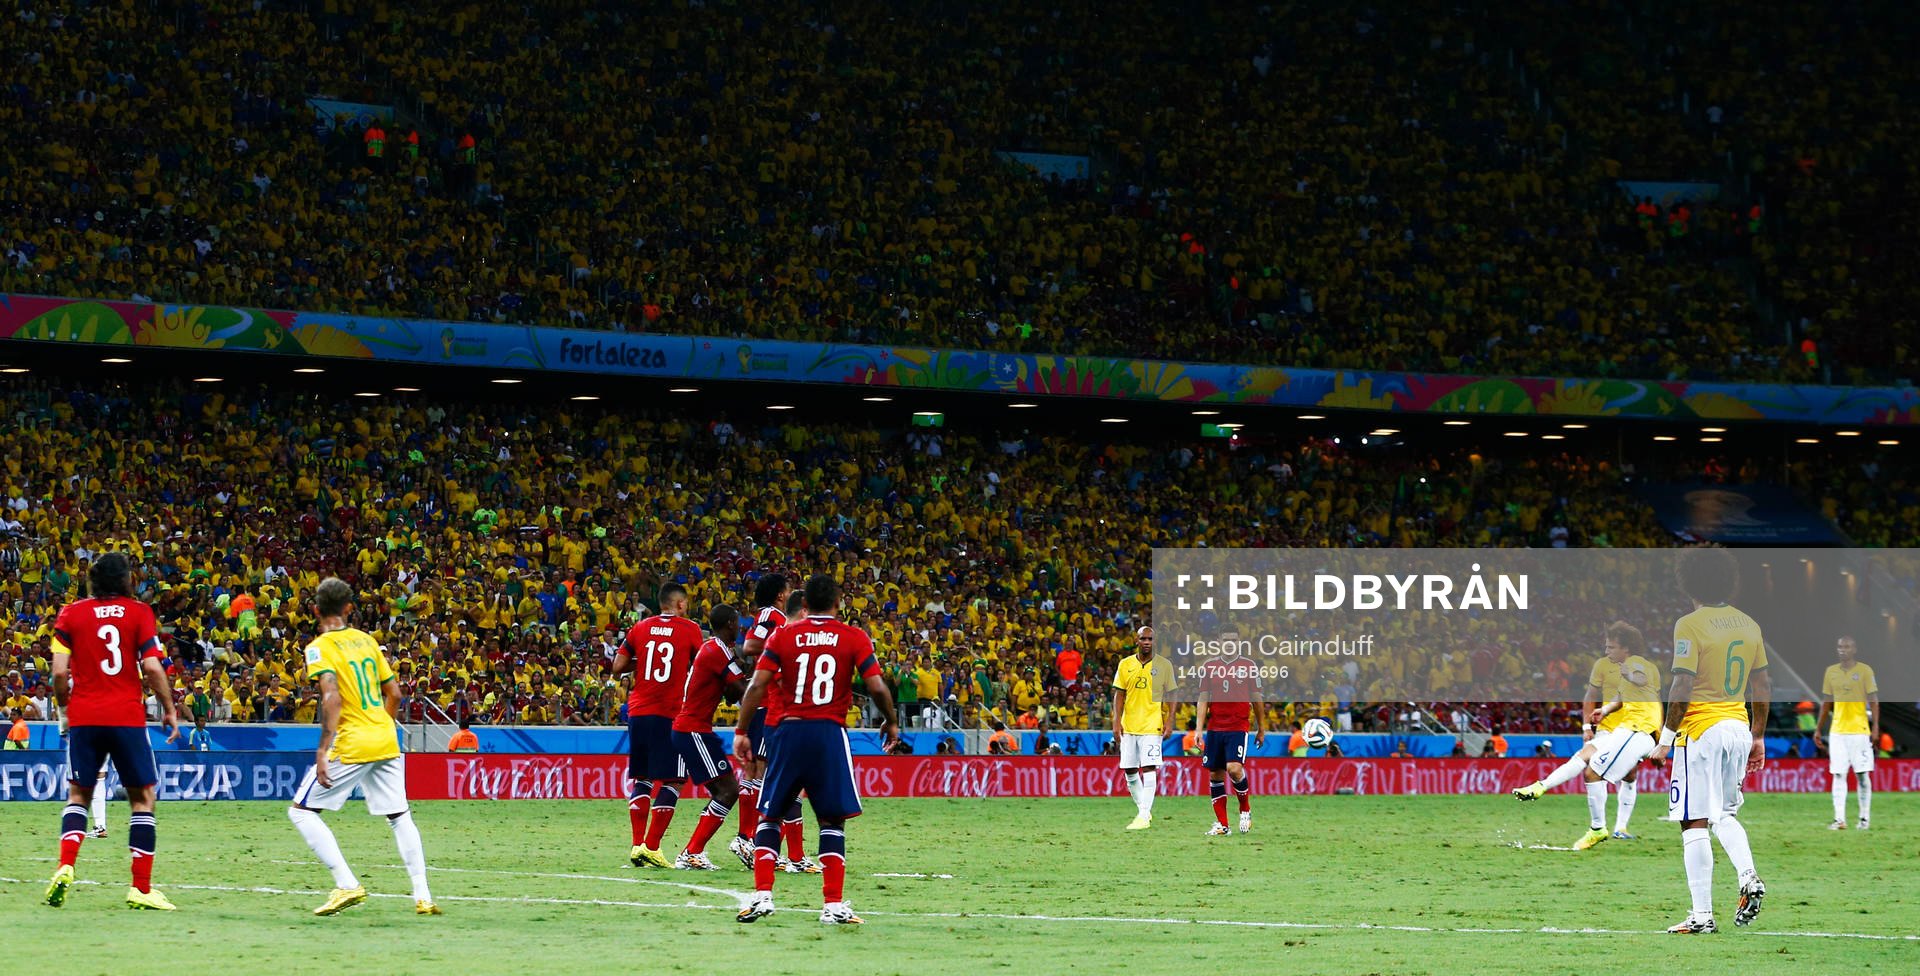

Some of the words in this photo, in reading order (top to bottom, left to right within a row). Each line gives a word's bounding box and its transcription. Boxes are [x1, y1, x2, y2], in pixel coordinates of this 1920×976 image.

[93, 605, 126, 619] YEPES
[97, 624, 123, 676] 3
[644, 640, 674, 683] 13
[1724, 640, 1745, 696] 6
[349, 656, 381, 710] 10
[794, 652, 837, 706] 18
[1135, 676, 1148, 689] 23
[1222, 679, 1230, 693] 9
[1147, 744, 1161, 758] 23
[1237, 744, 1244, 758] 9
[1598, 751, 1610, 765] 4
[1670, 779, 1680, 804] 6
